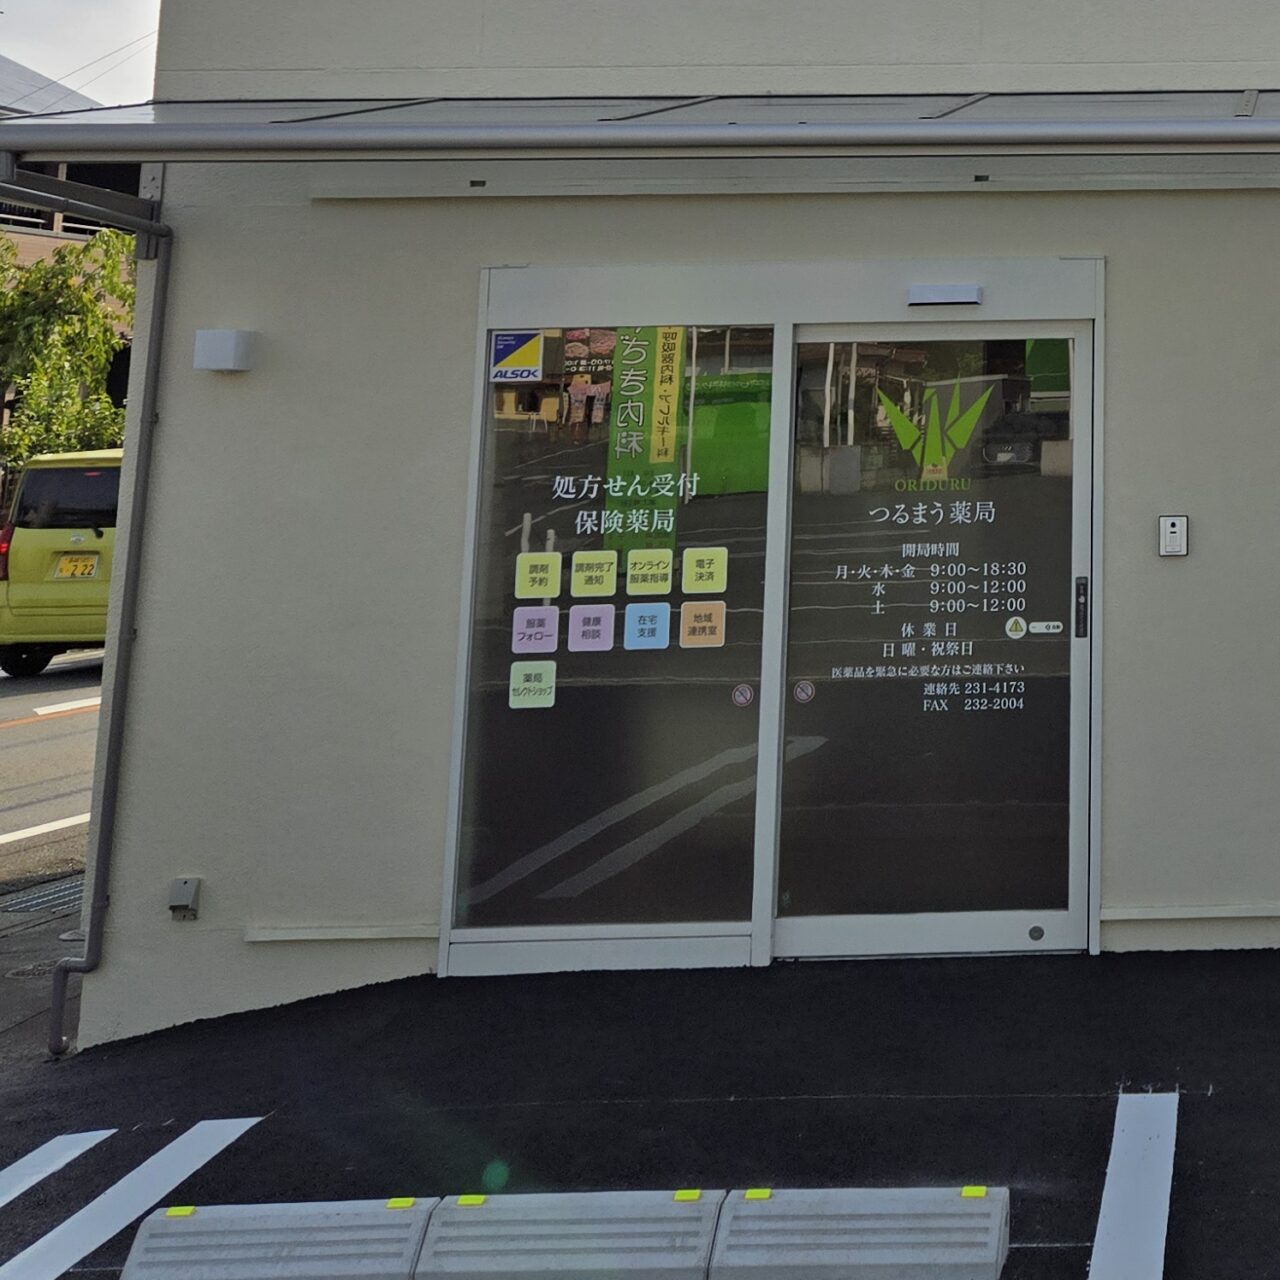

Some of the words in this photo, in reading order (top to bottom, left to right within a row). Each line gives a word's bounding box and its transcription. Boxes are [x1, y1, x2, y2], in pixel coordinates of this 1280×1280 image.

[493, 369, 539, 379] ALSOK
[552, 473, 700, 500] 処方せん受付
[895, 478, 972, 492] ORIDURU
[869, 500, 996, 525] つるまう薬局
[575, 508, 675, 535] 保険薬局
[902, 542, 960, 558] 開局時間
[630, 560, 670, 571] オンライン
[695, 559, 715, 569] 電子
[835, 563, 916, 580] 月・火・木・金
[528, 576, 549, 587] 予約
[695, 571, 714, 582] 決済
[871, 581, 886, 597] 水
[870, 599, 886, 615] 土
[638, 615, 658, 626] 在宅
[517, 631, 553, 642] フォロー
[882, 641, 974, 658] 日曜・祝祭日
[831, 663, 1026, 679] 医薬品を緊急に必要な方はご連絡下さい
[923, 682, 960, 696] 連絡先
[964, 681, 1025, 694] 231-4173
[923, 699, 948, 712] FAX
[964, 697, 1025, 711] 232-2004
